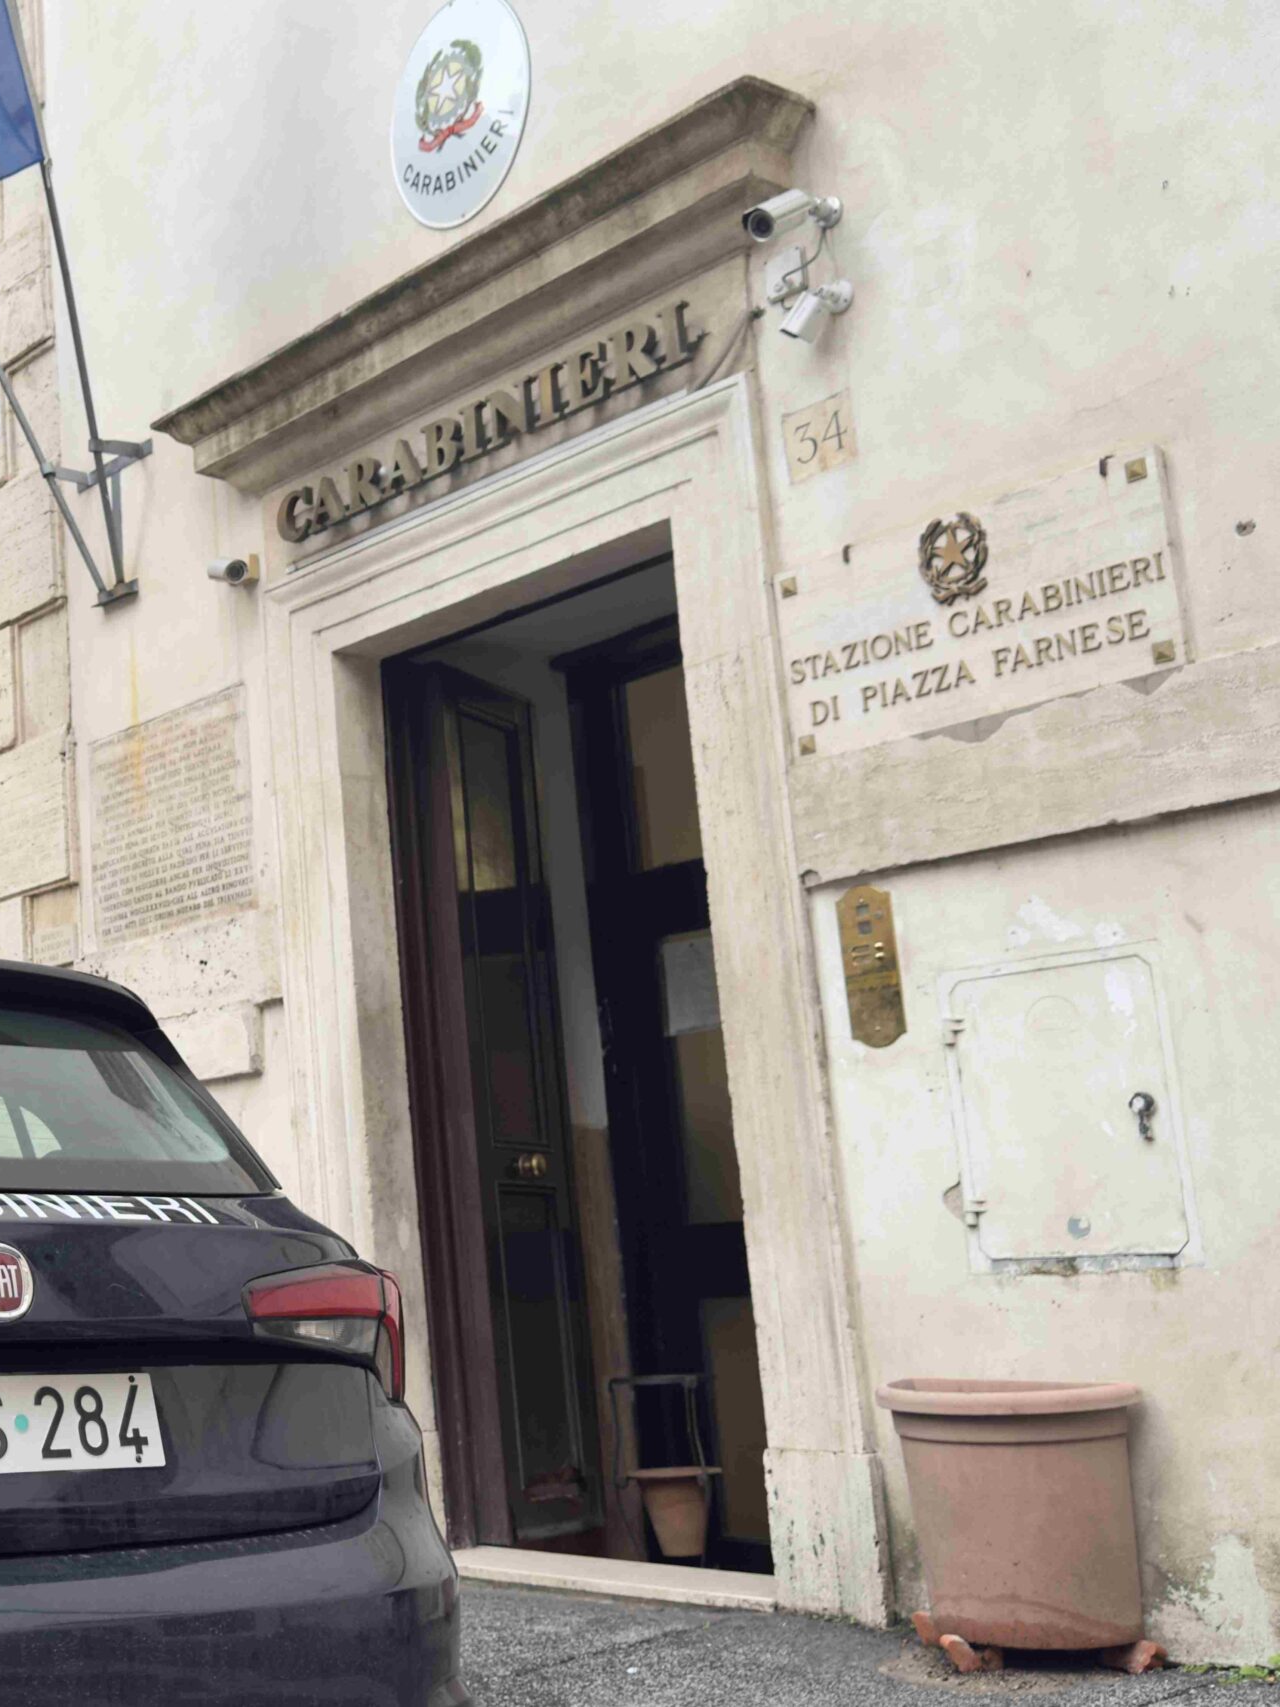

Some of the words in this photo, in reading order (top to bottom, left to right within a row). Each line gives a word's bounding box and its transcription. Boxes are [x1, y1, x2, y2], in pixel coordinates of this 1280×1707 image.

[403, 108, 514, 197] CARABINIERI
[276, 300, 706, 544] CARABINIERI
[794, 409, 847, 464] 34
[790, 620, 934, 685] STAZIONE
[948, 551, 1166, 640] CARABINIERI
[810, 694, 841, 727] DI
[862, 658, 975, 714] PIAZZA
[992, 608, 1150, 678] FARNESE
